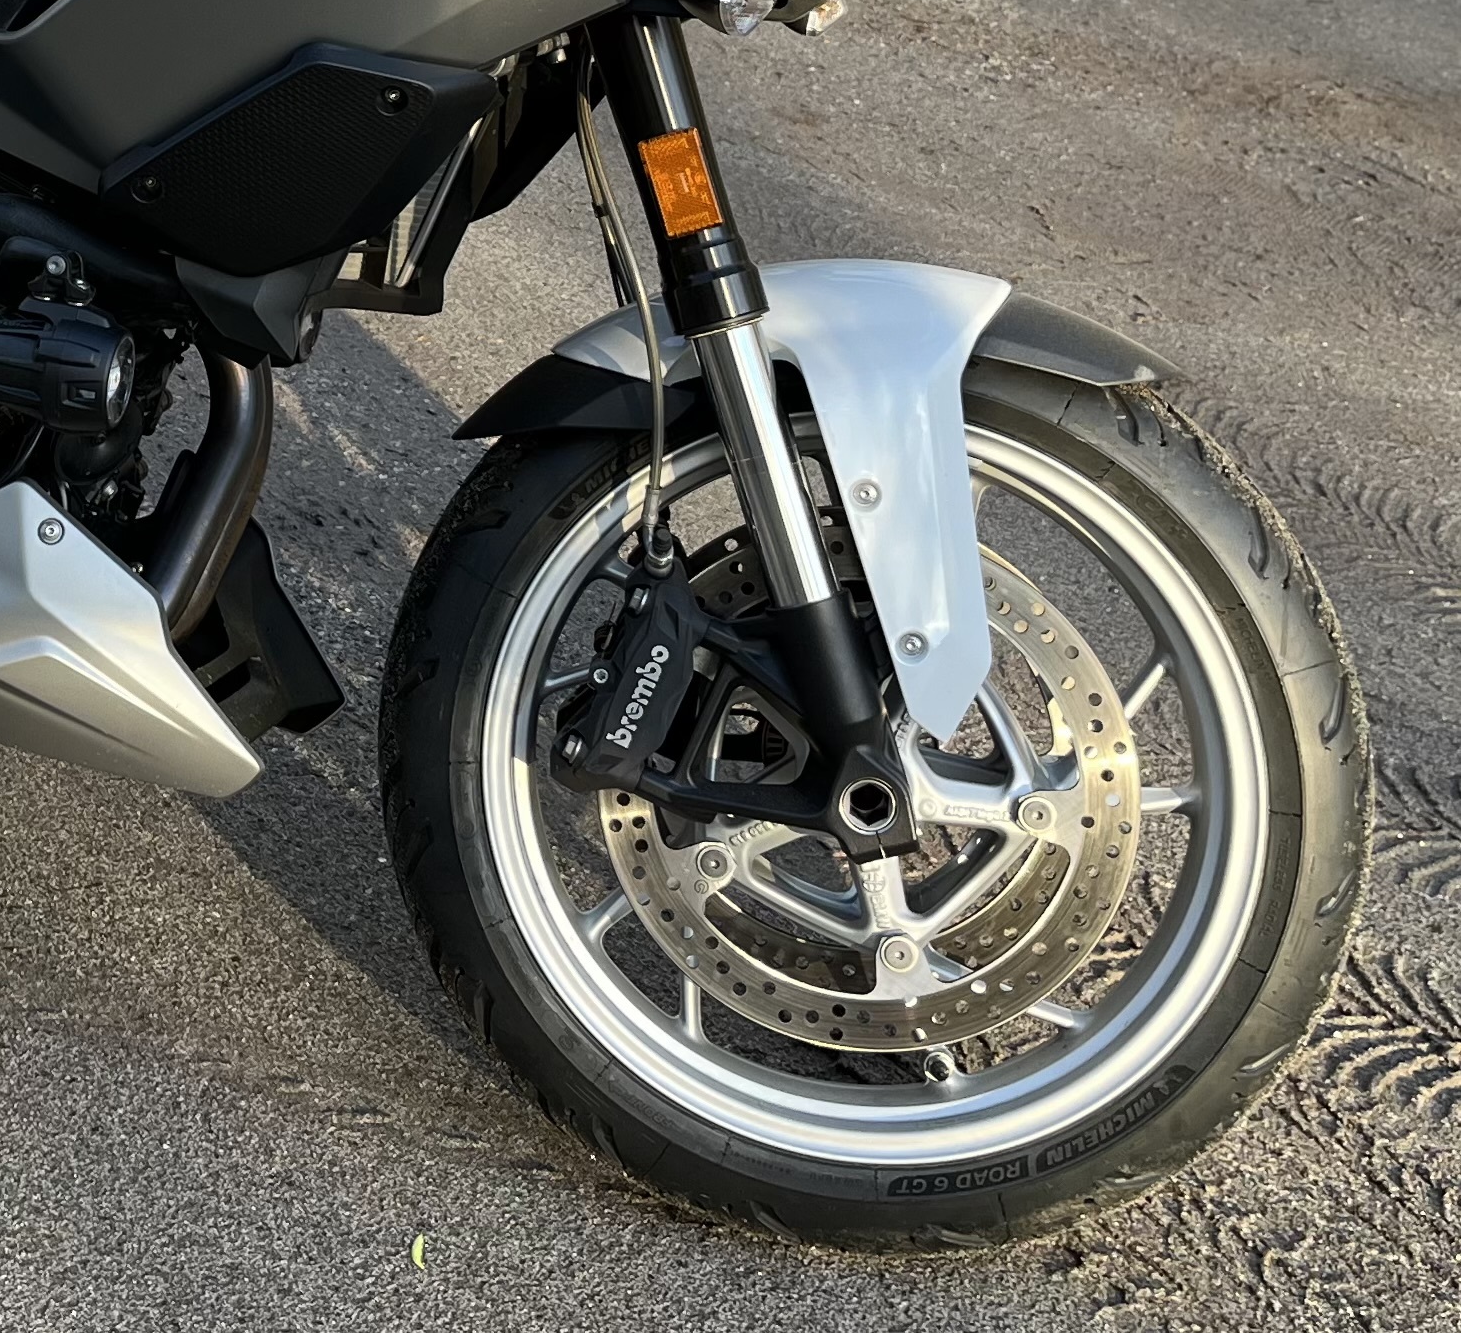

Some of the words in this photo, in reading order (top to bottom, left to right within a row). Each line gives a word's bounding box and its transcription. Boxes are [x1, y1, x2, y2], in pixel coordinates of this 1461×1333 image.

[605, 644, 670, 749] brembo
[1046, 1090, 1156, 1166] MICHELIN
[896, 1178, 928, 1196] GT
[933, 1174, 950, 1192] 6
[955, 1164, 1021, 1191] ROAD
